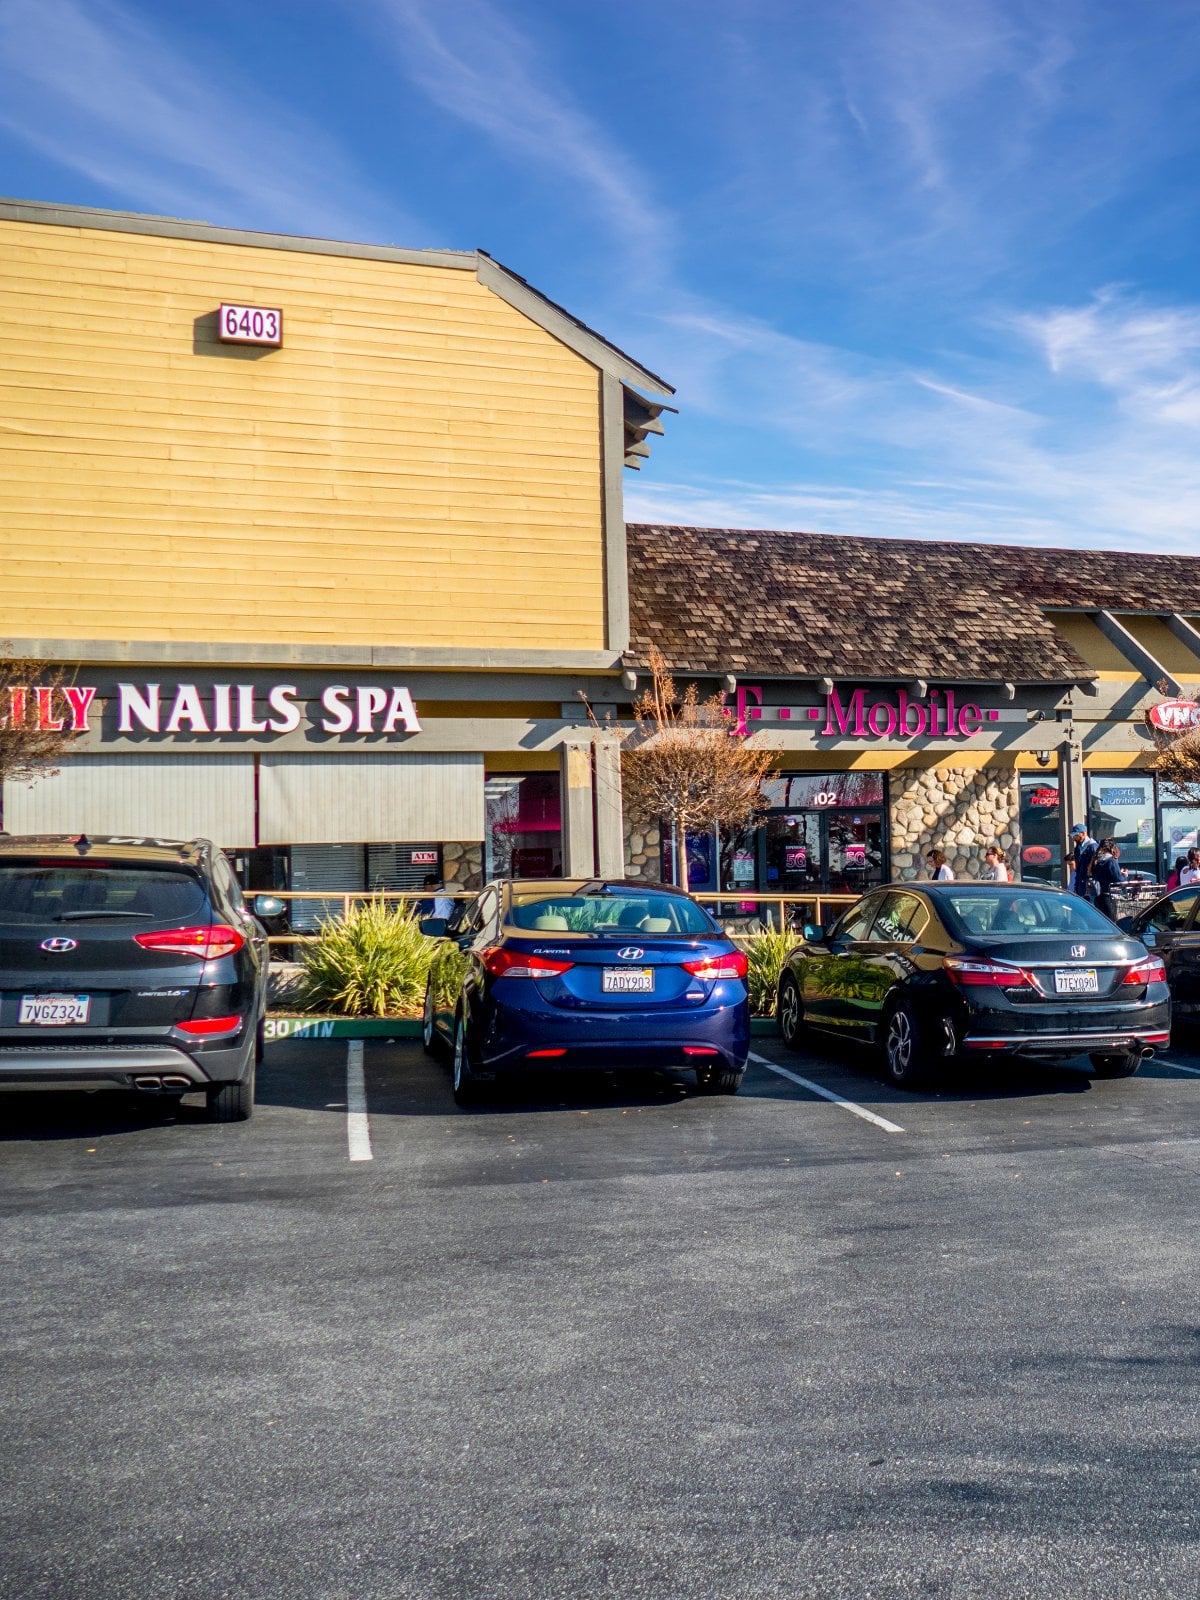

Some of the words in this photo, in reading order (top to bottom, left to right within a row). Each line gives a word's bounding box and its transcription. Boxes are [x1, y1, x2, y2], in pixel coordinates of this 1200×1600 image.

[226, 308, 277, 338] 6403
[0, 686, 96, 731] ILY
[118, 683, 301, 734] NAILS
[321, 685, 422, 734] SPA
[821, 688, 983, 737] Mobile
[814, 792, 837, 805] 102
[1103, 797, 1142, 805] Nutrition
[606, 976, 651, 989] 7ADY903
[25, 1005, 84, 1019] 7VGZ324
[264, 1020, 289, 1037] 30
[294, 1021, 335, 1037] MIN
